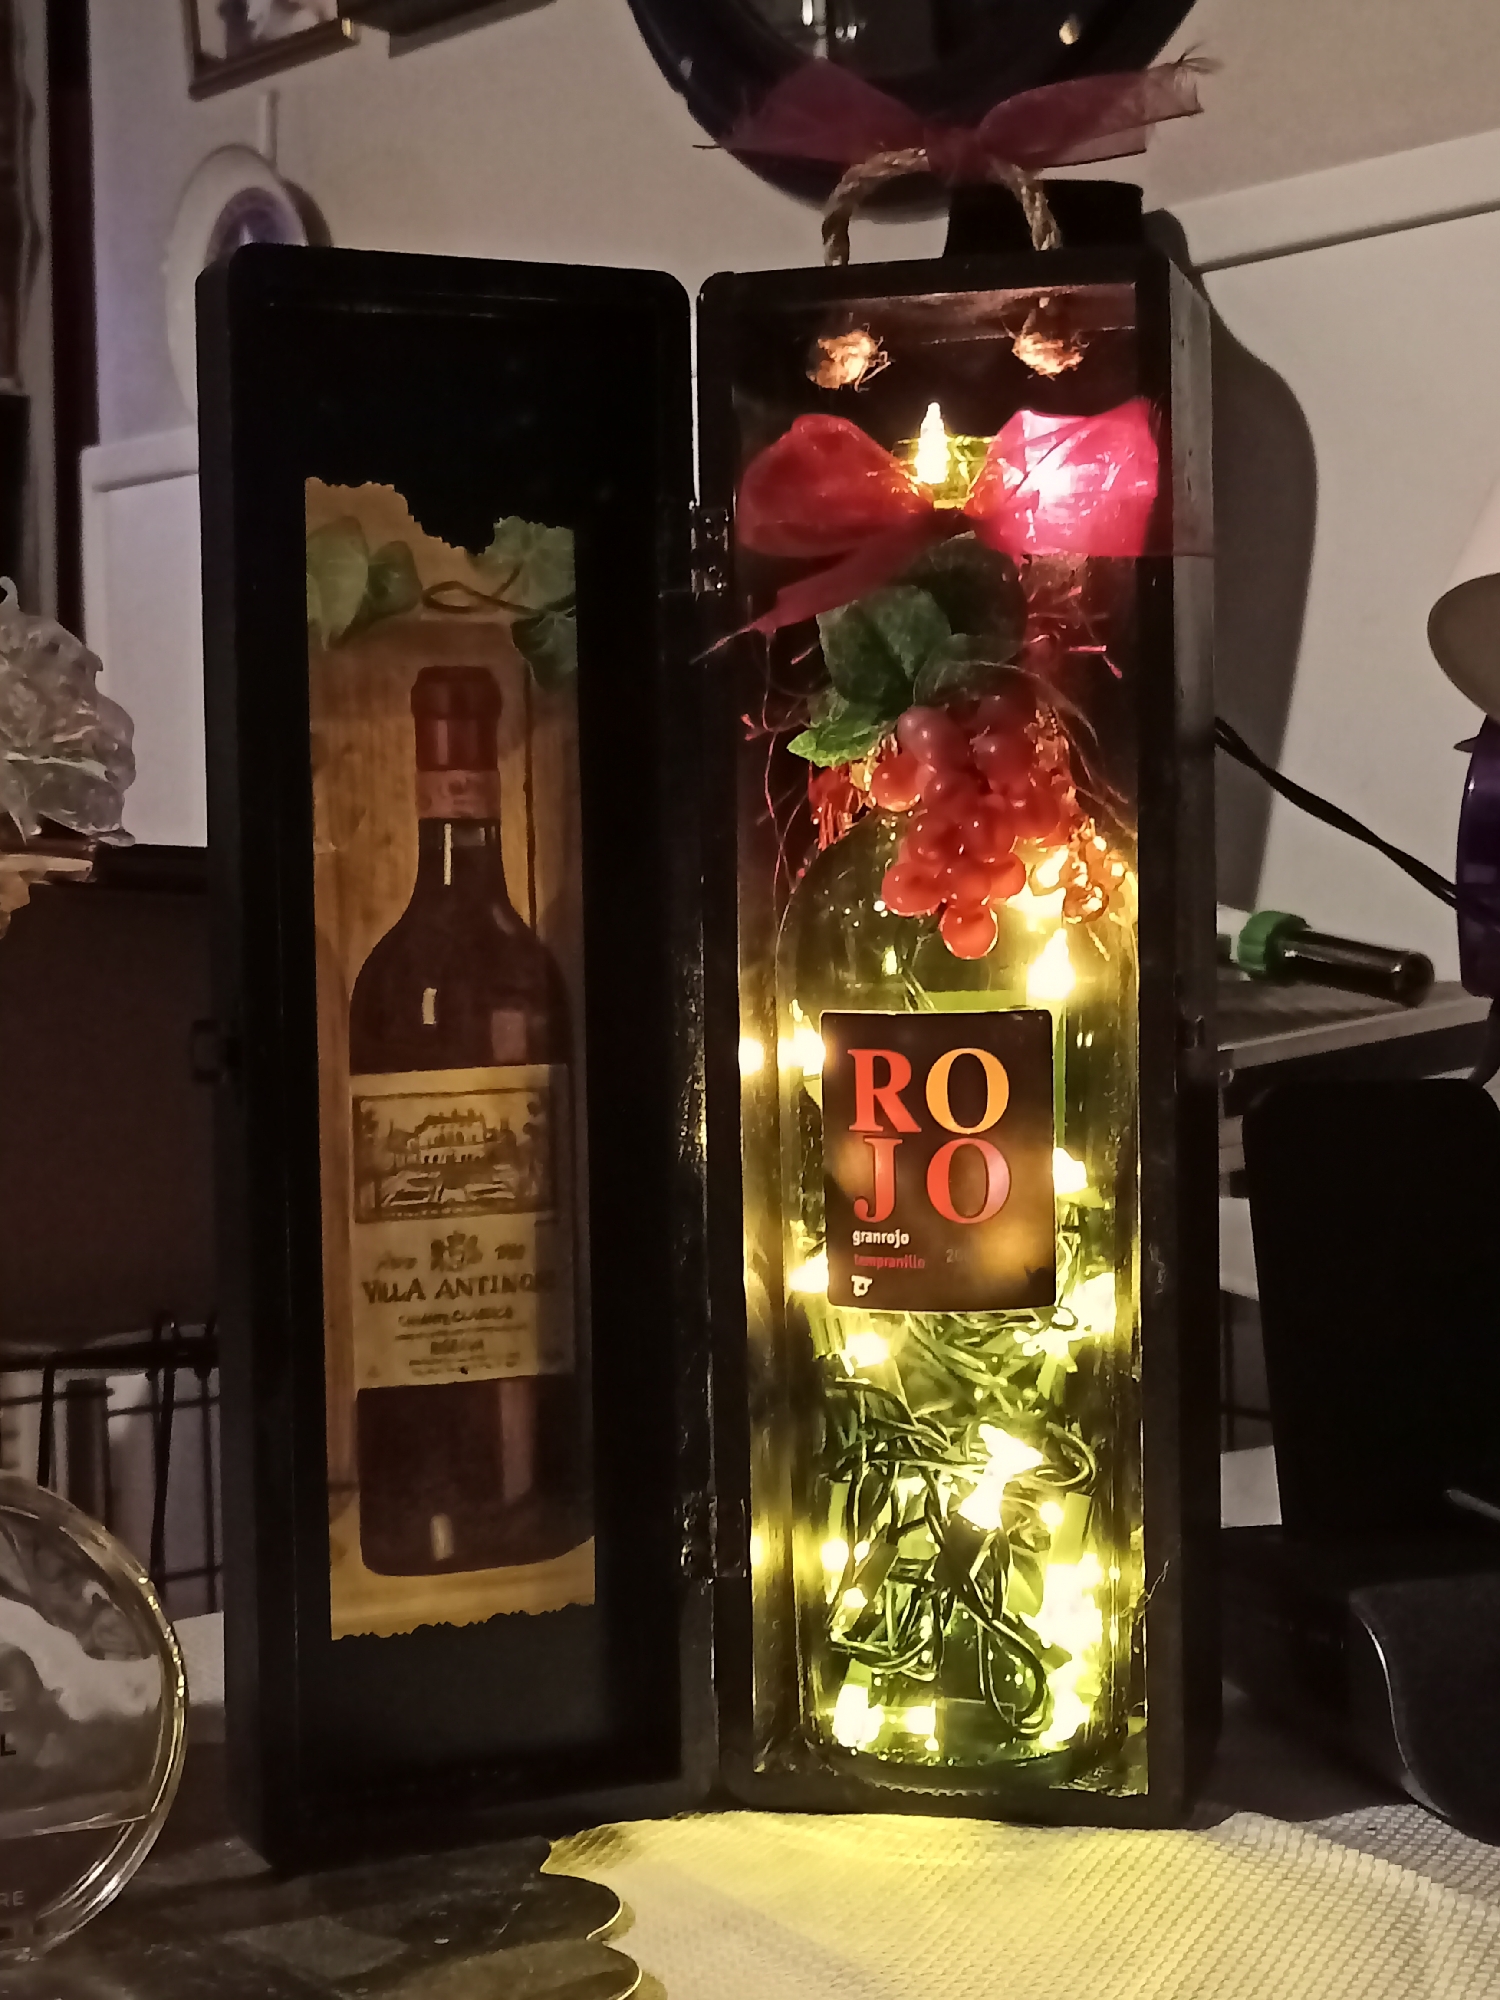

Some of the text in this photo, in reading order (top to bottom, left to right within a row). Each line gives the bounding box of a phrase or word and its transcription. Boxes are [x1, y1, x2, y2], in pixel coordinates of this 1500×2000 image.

[847, 1047, 1010, 1135] RO
[853, 1136, 1011, 1225] JO
[852, 1229, 910, 1249] granrojo
[854, 1253, 926, 1271] tempranillo
[361, 1277, 426, 1303] VILLA
